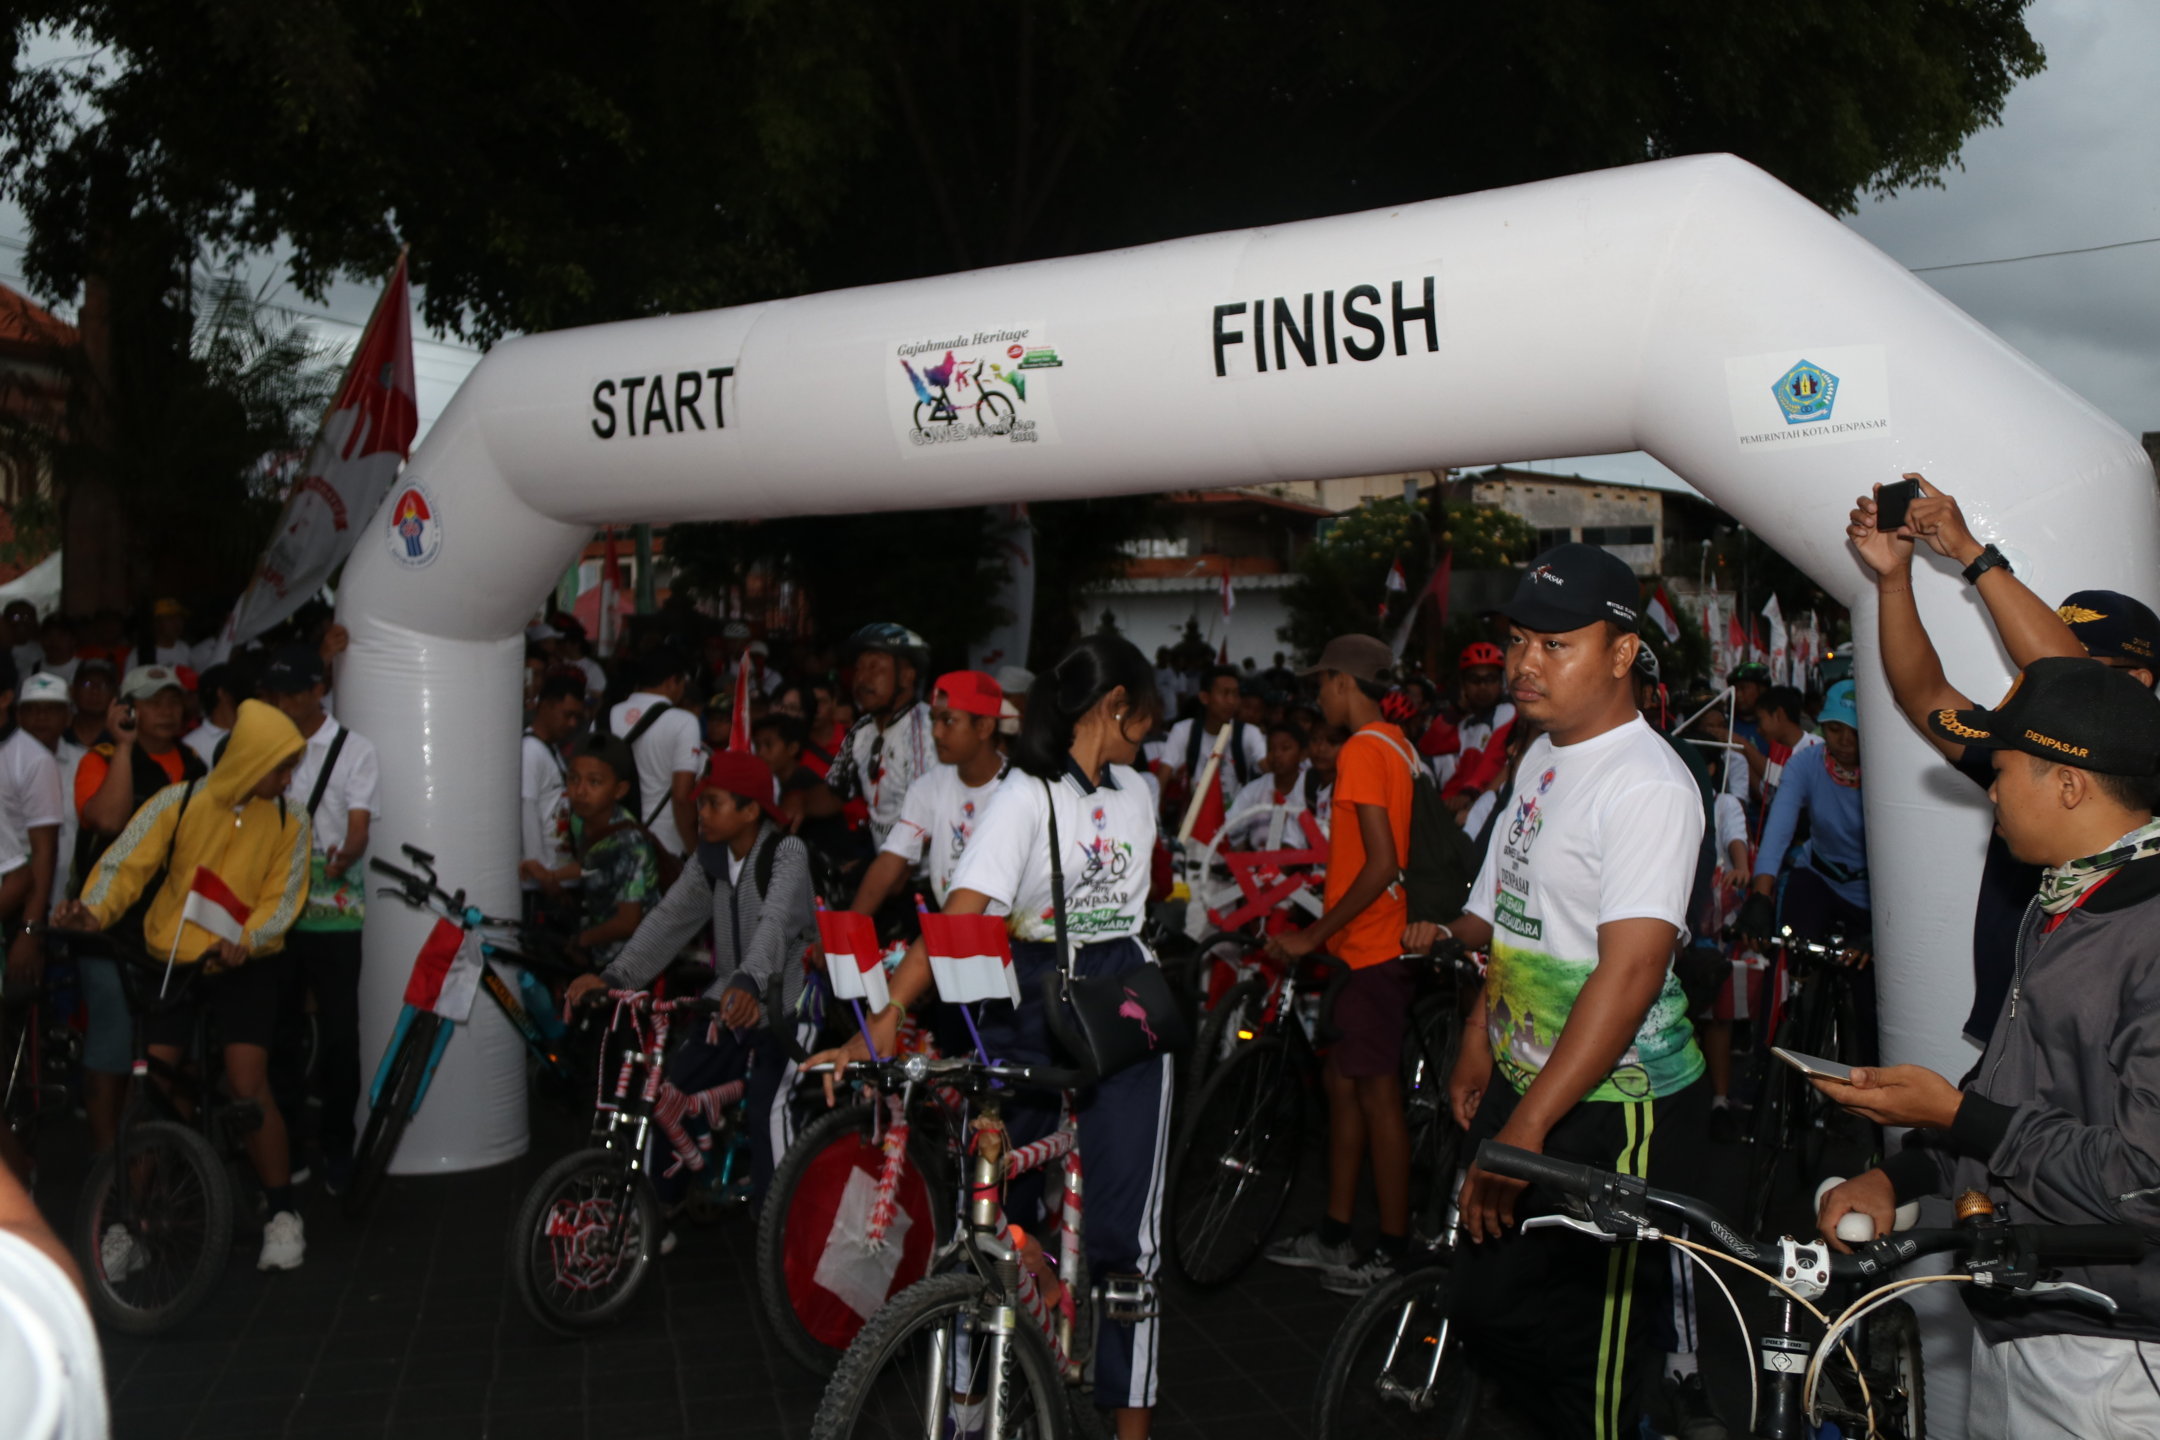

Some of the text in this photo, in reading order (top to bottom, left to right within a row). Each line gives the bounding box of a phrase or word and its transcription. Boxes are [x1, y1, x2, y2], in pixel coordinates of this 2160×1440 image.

[1213, 276, 1439, 377] FINISH
[897, 328, 1029, 357] Gajahmada Heritage
[591, 366, 734, 439] START
[1740, 418, 1888, 445] PEMERINTAH KOTA DENPASAR
[2024, 729, 2090, 759] DENPASAR
